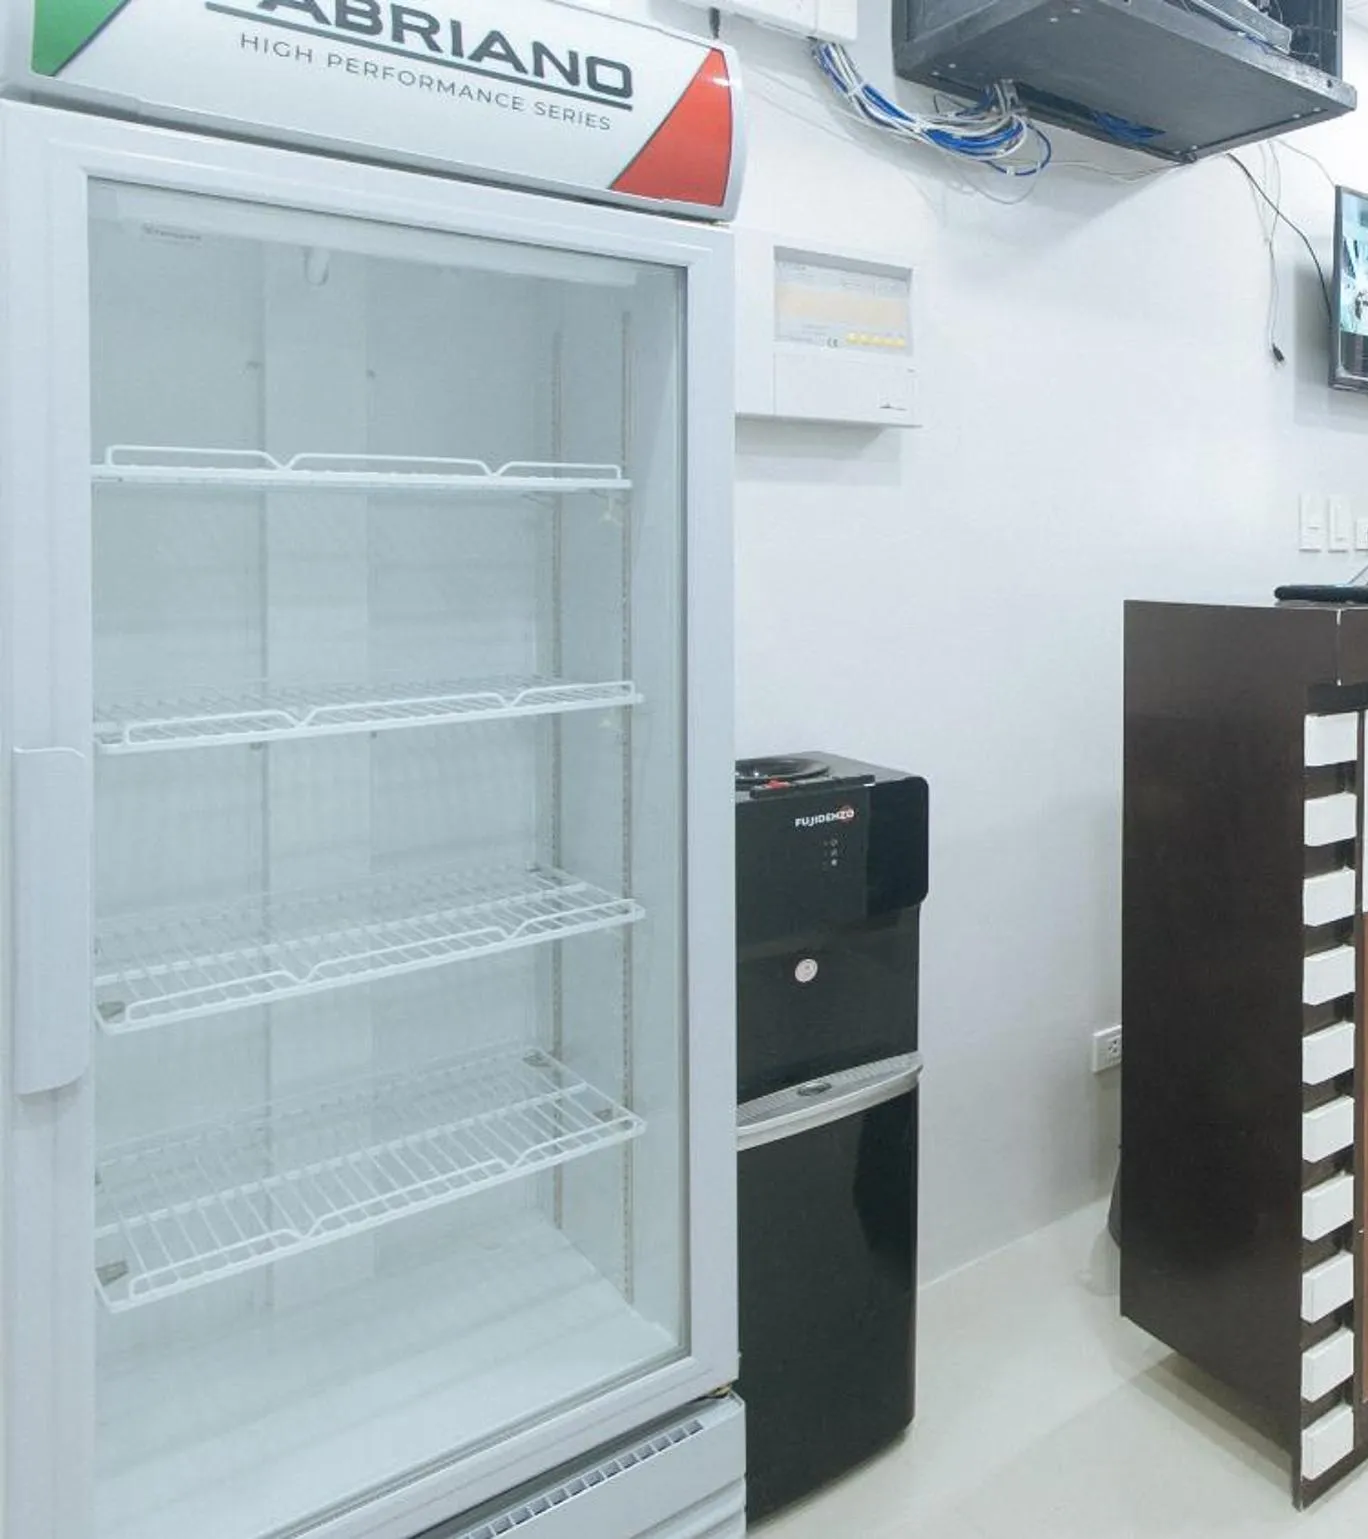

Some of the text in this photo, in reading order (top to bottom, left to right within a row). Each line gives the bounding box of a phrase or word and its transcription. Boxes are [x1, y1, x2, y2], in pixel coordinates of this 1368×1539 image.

[240, 33, 611, 131] HIGH PERFORMANCE SERIES
